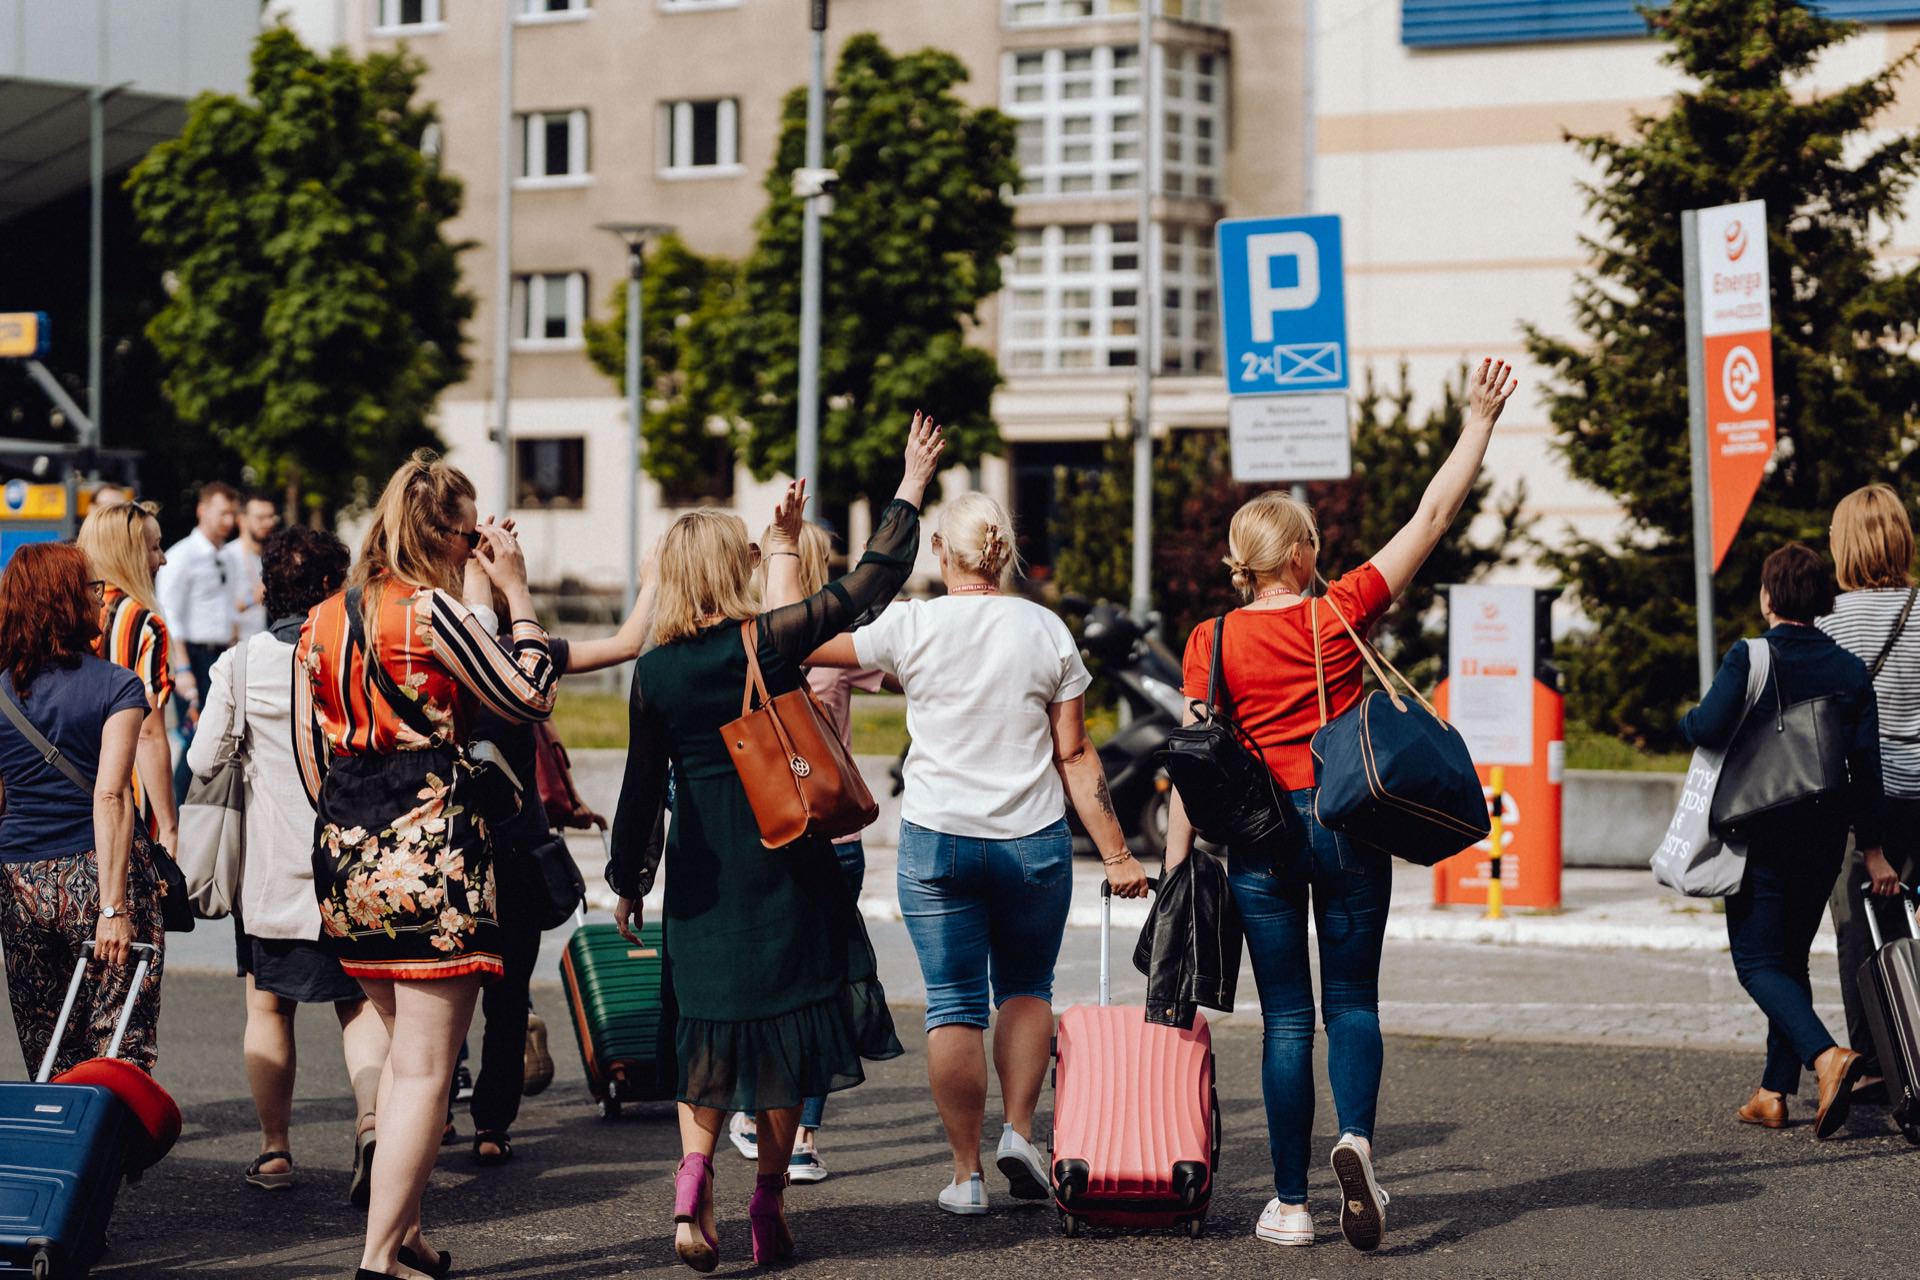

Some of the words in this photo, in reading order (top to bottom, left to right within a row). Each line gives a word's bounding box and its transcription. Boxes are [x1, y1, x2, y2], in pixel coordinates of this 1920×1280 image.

[1247, 231, 1320, 343] P
[1713, 271, 1761, 296] Energa
[1241, 352, 1274, 382] 2x
[1687, 767, 1715, 790] MY
